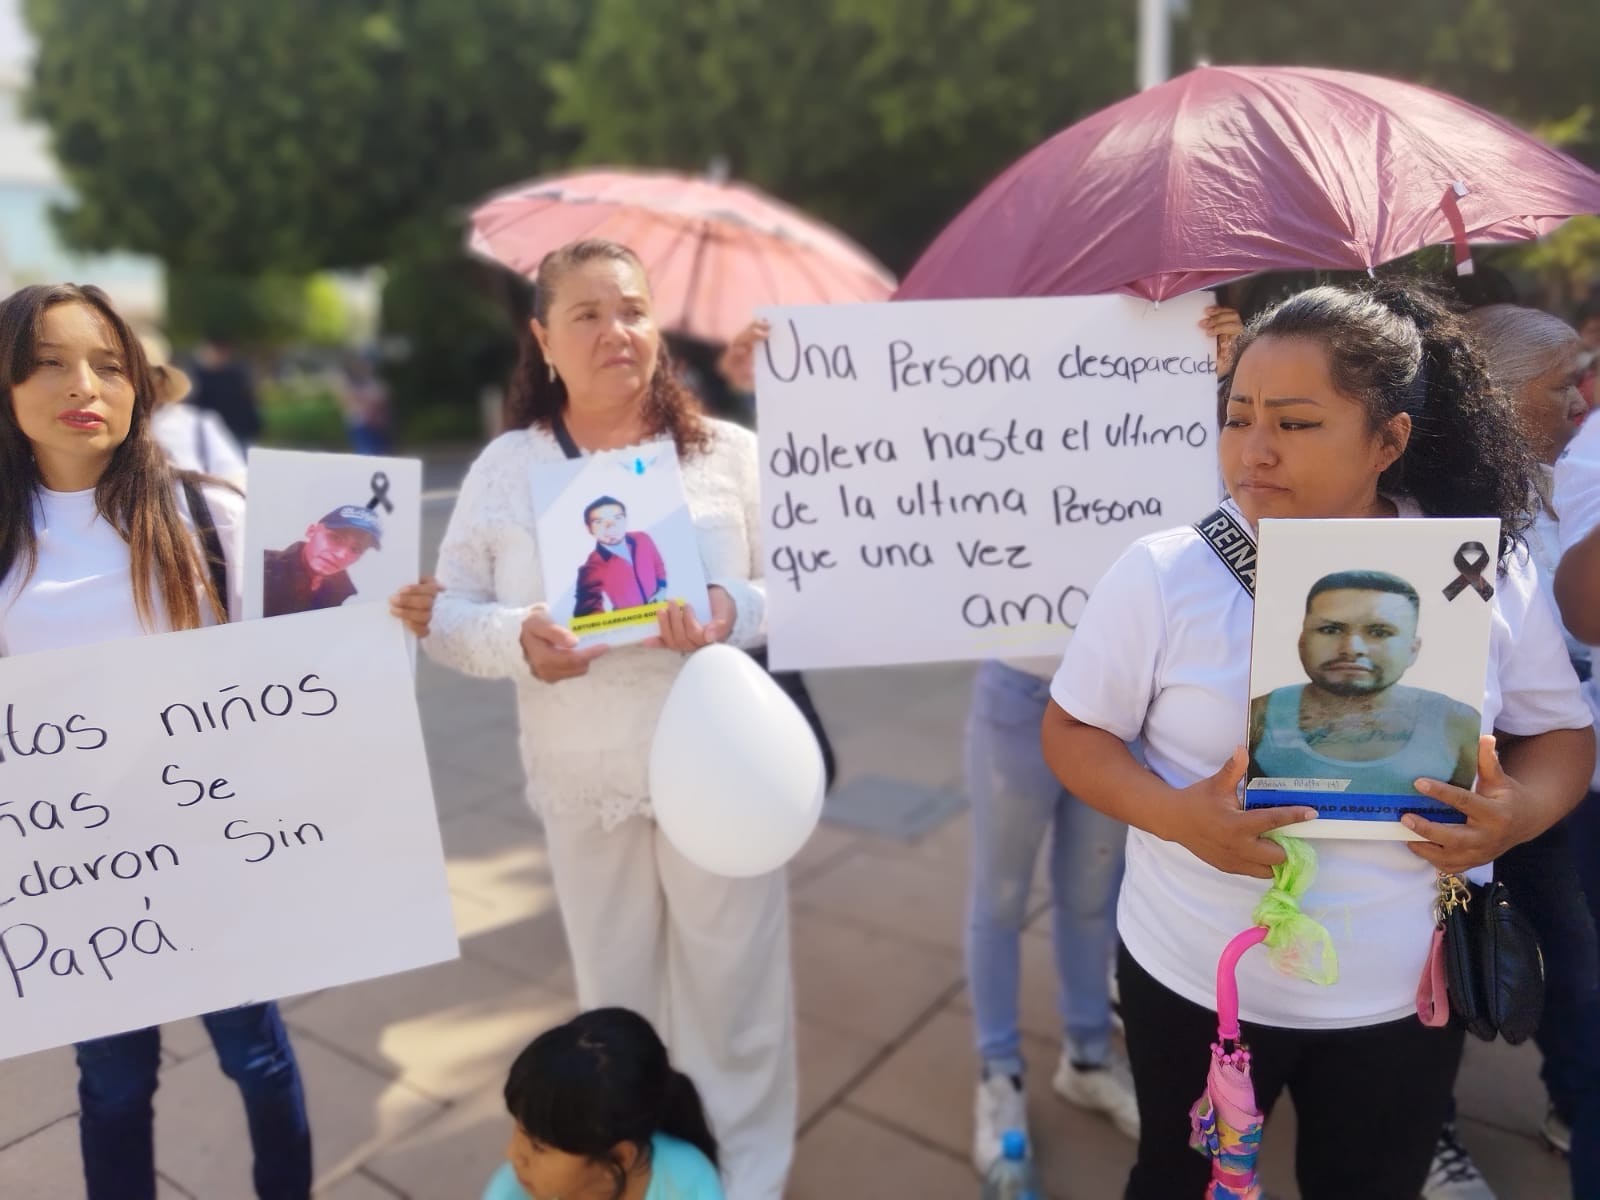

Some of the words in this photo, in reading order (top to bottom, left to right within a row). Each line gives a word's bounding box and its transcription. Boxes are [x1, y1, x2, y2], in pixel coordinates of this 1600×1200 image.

[765, 319, 857, 382] Una
[769, 431, 897, 479] dolera
[922, 419, 1045, 463] hasta
[1061, 419, 1089, 452] el
[1105, 412, 1207, 449] ultimo
[771, 491, 817, 530] de
[839, 484, 875, 520] la
[895, 479, 1028, 518] ultima
[771, 546, 837, 593] que
[859, 543, 934, 569] una
[0, 703, 108, 764] tos
[159, 673, 338, 738] niños
[1340, 805, 1392, 814] ARAUJO
[0, 843, 180, 908] daron
